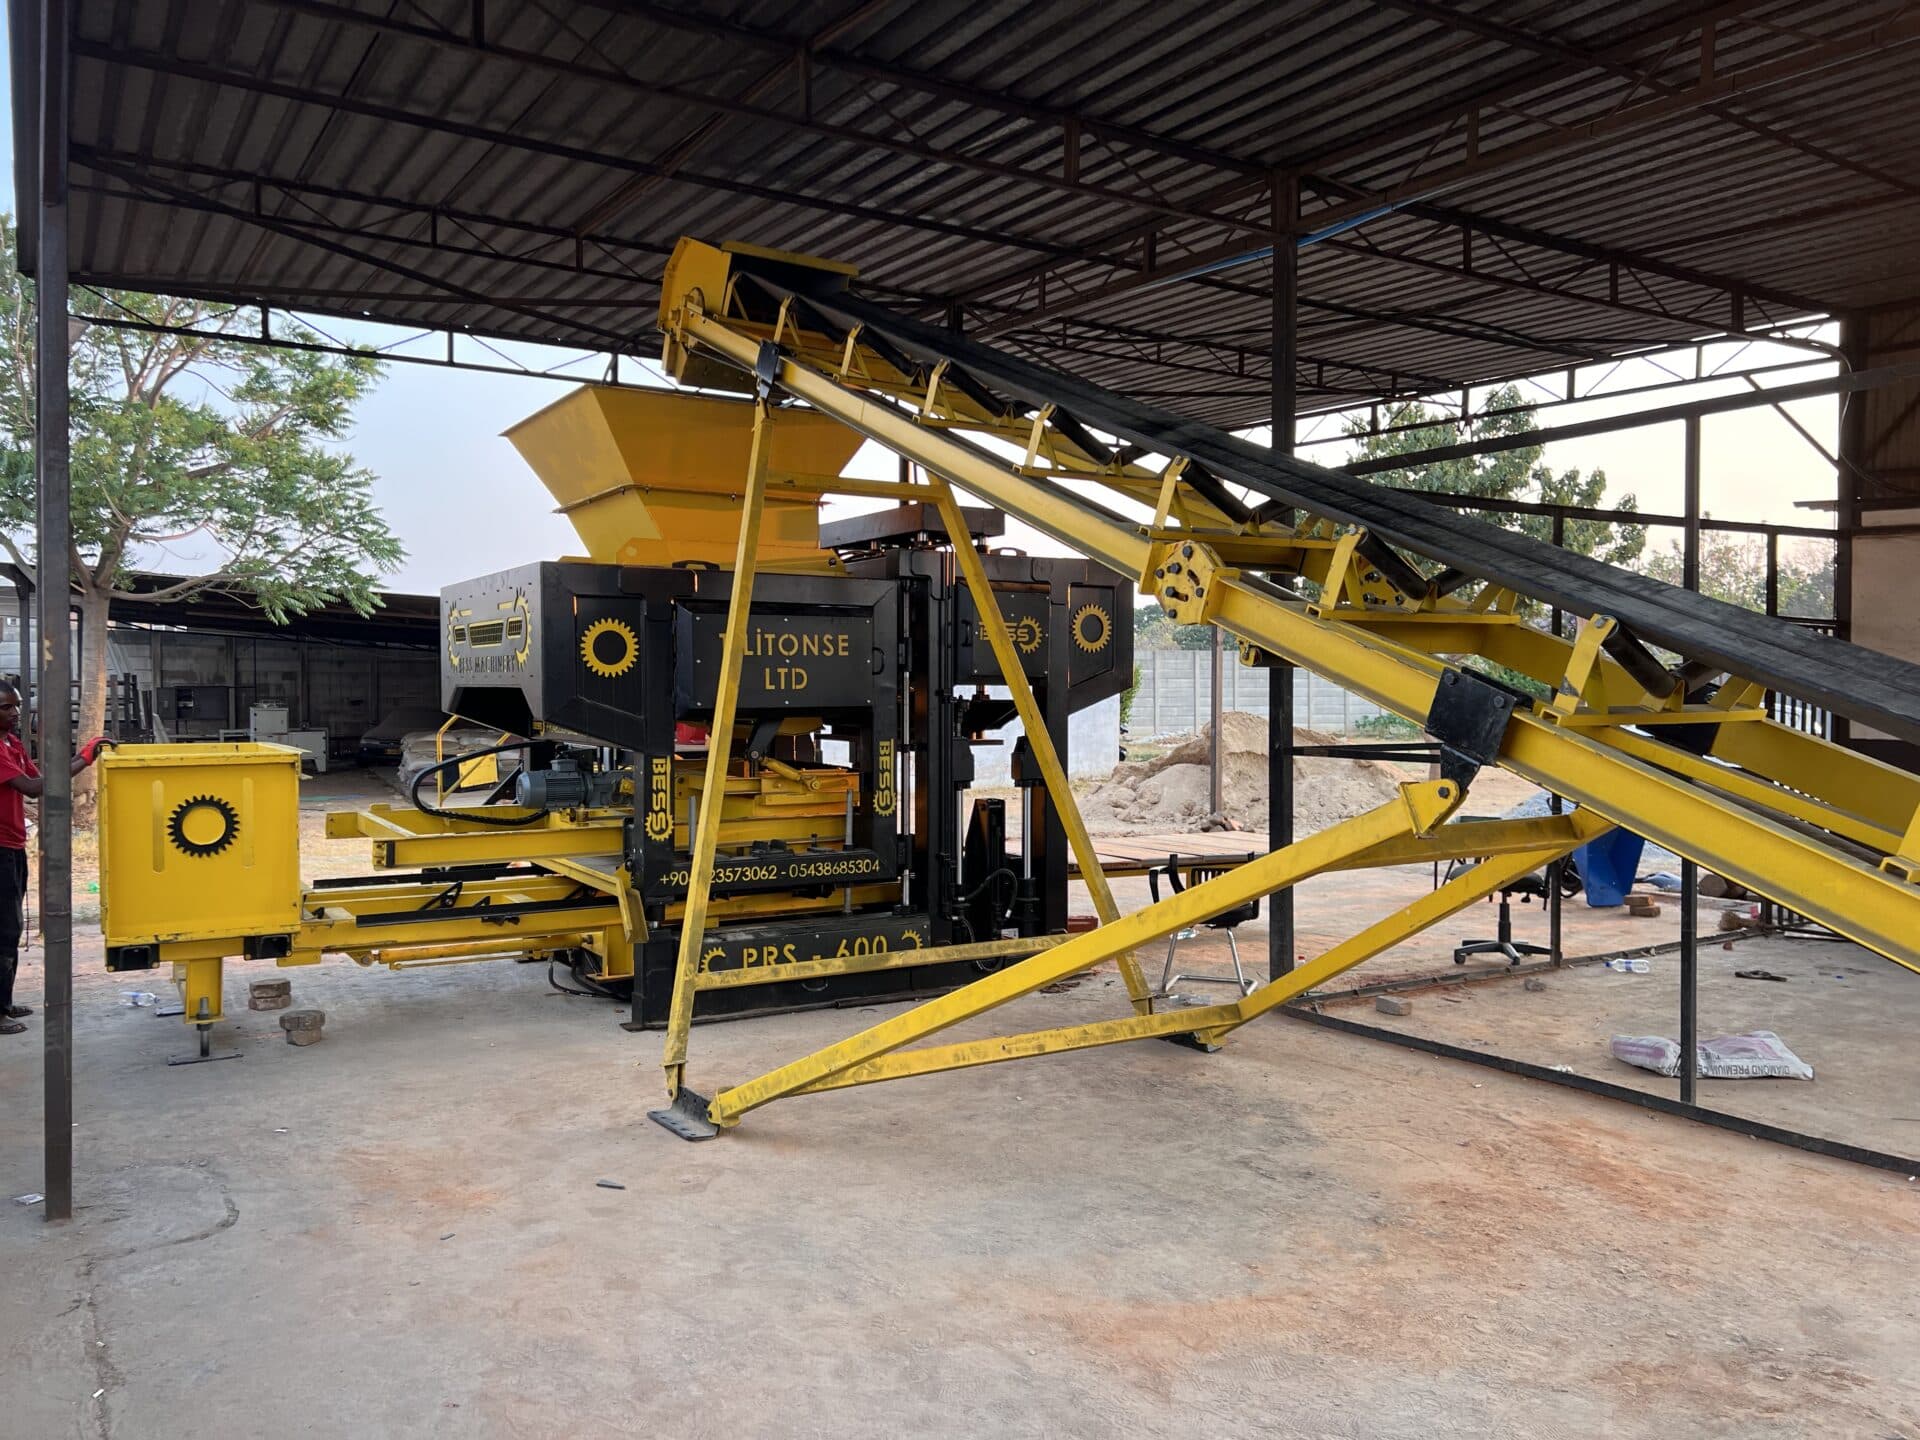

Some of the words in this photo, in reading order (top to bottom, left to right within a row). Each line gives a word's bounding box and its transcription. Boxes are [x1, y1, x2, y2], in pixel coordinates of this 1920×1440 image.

[475, 655, 515, 673] MACHINERY
[765, 668, 808, 689] LTD
[660, 864, 778, 886] +9023573062
[789, 859, 880, 878] 05438685304
[743, 944, 797, 969] PRS
[836, 935, 888, 958] 600
[1711, 1064, 1750, 1076] PREMIUM
[1751, 1065, 1790, 1075] DIAMOND
